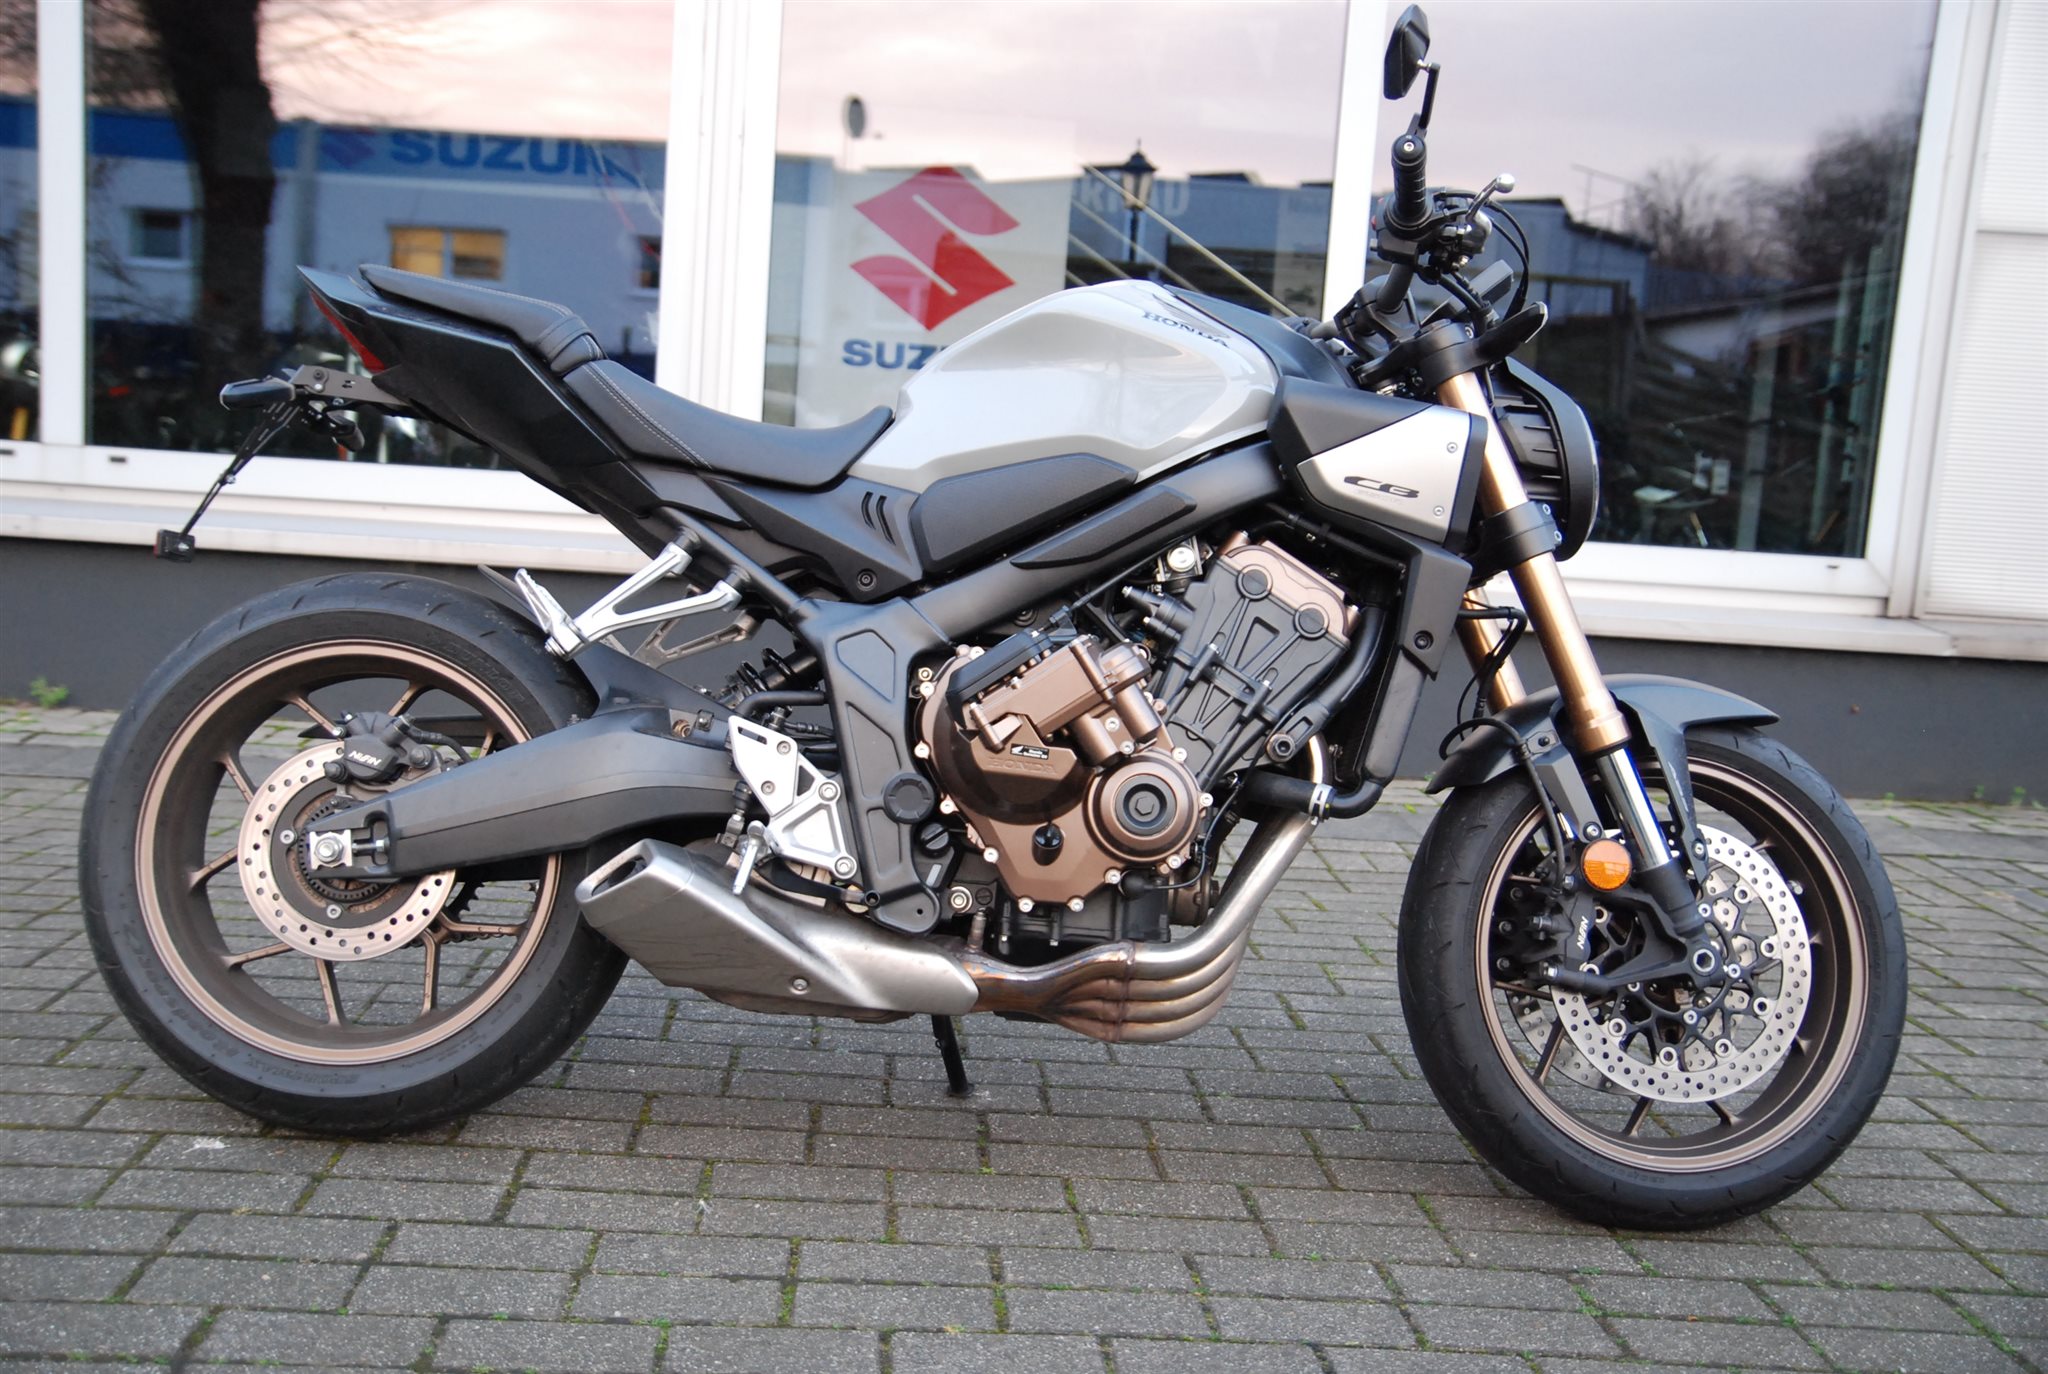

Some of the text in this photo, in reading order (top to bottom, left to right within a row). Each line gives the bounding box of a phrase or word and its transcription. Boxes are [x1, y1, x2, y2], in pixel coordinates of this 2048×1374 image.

[1142, 311, 1231, 348] HONDA
[842, 338, 948, 370] SUZ
[1343, 475, 1420, 499] CB
